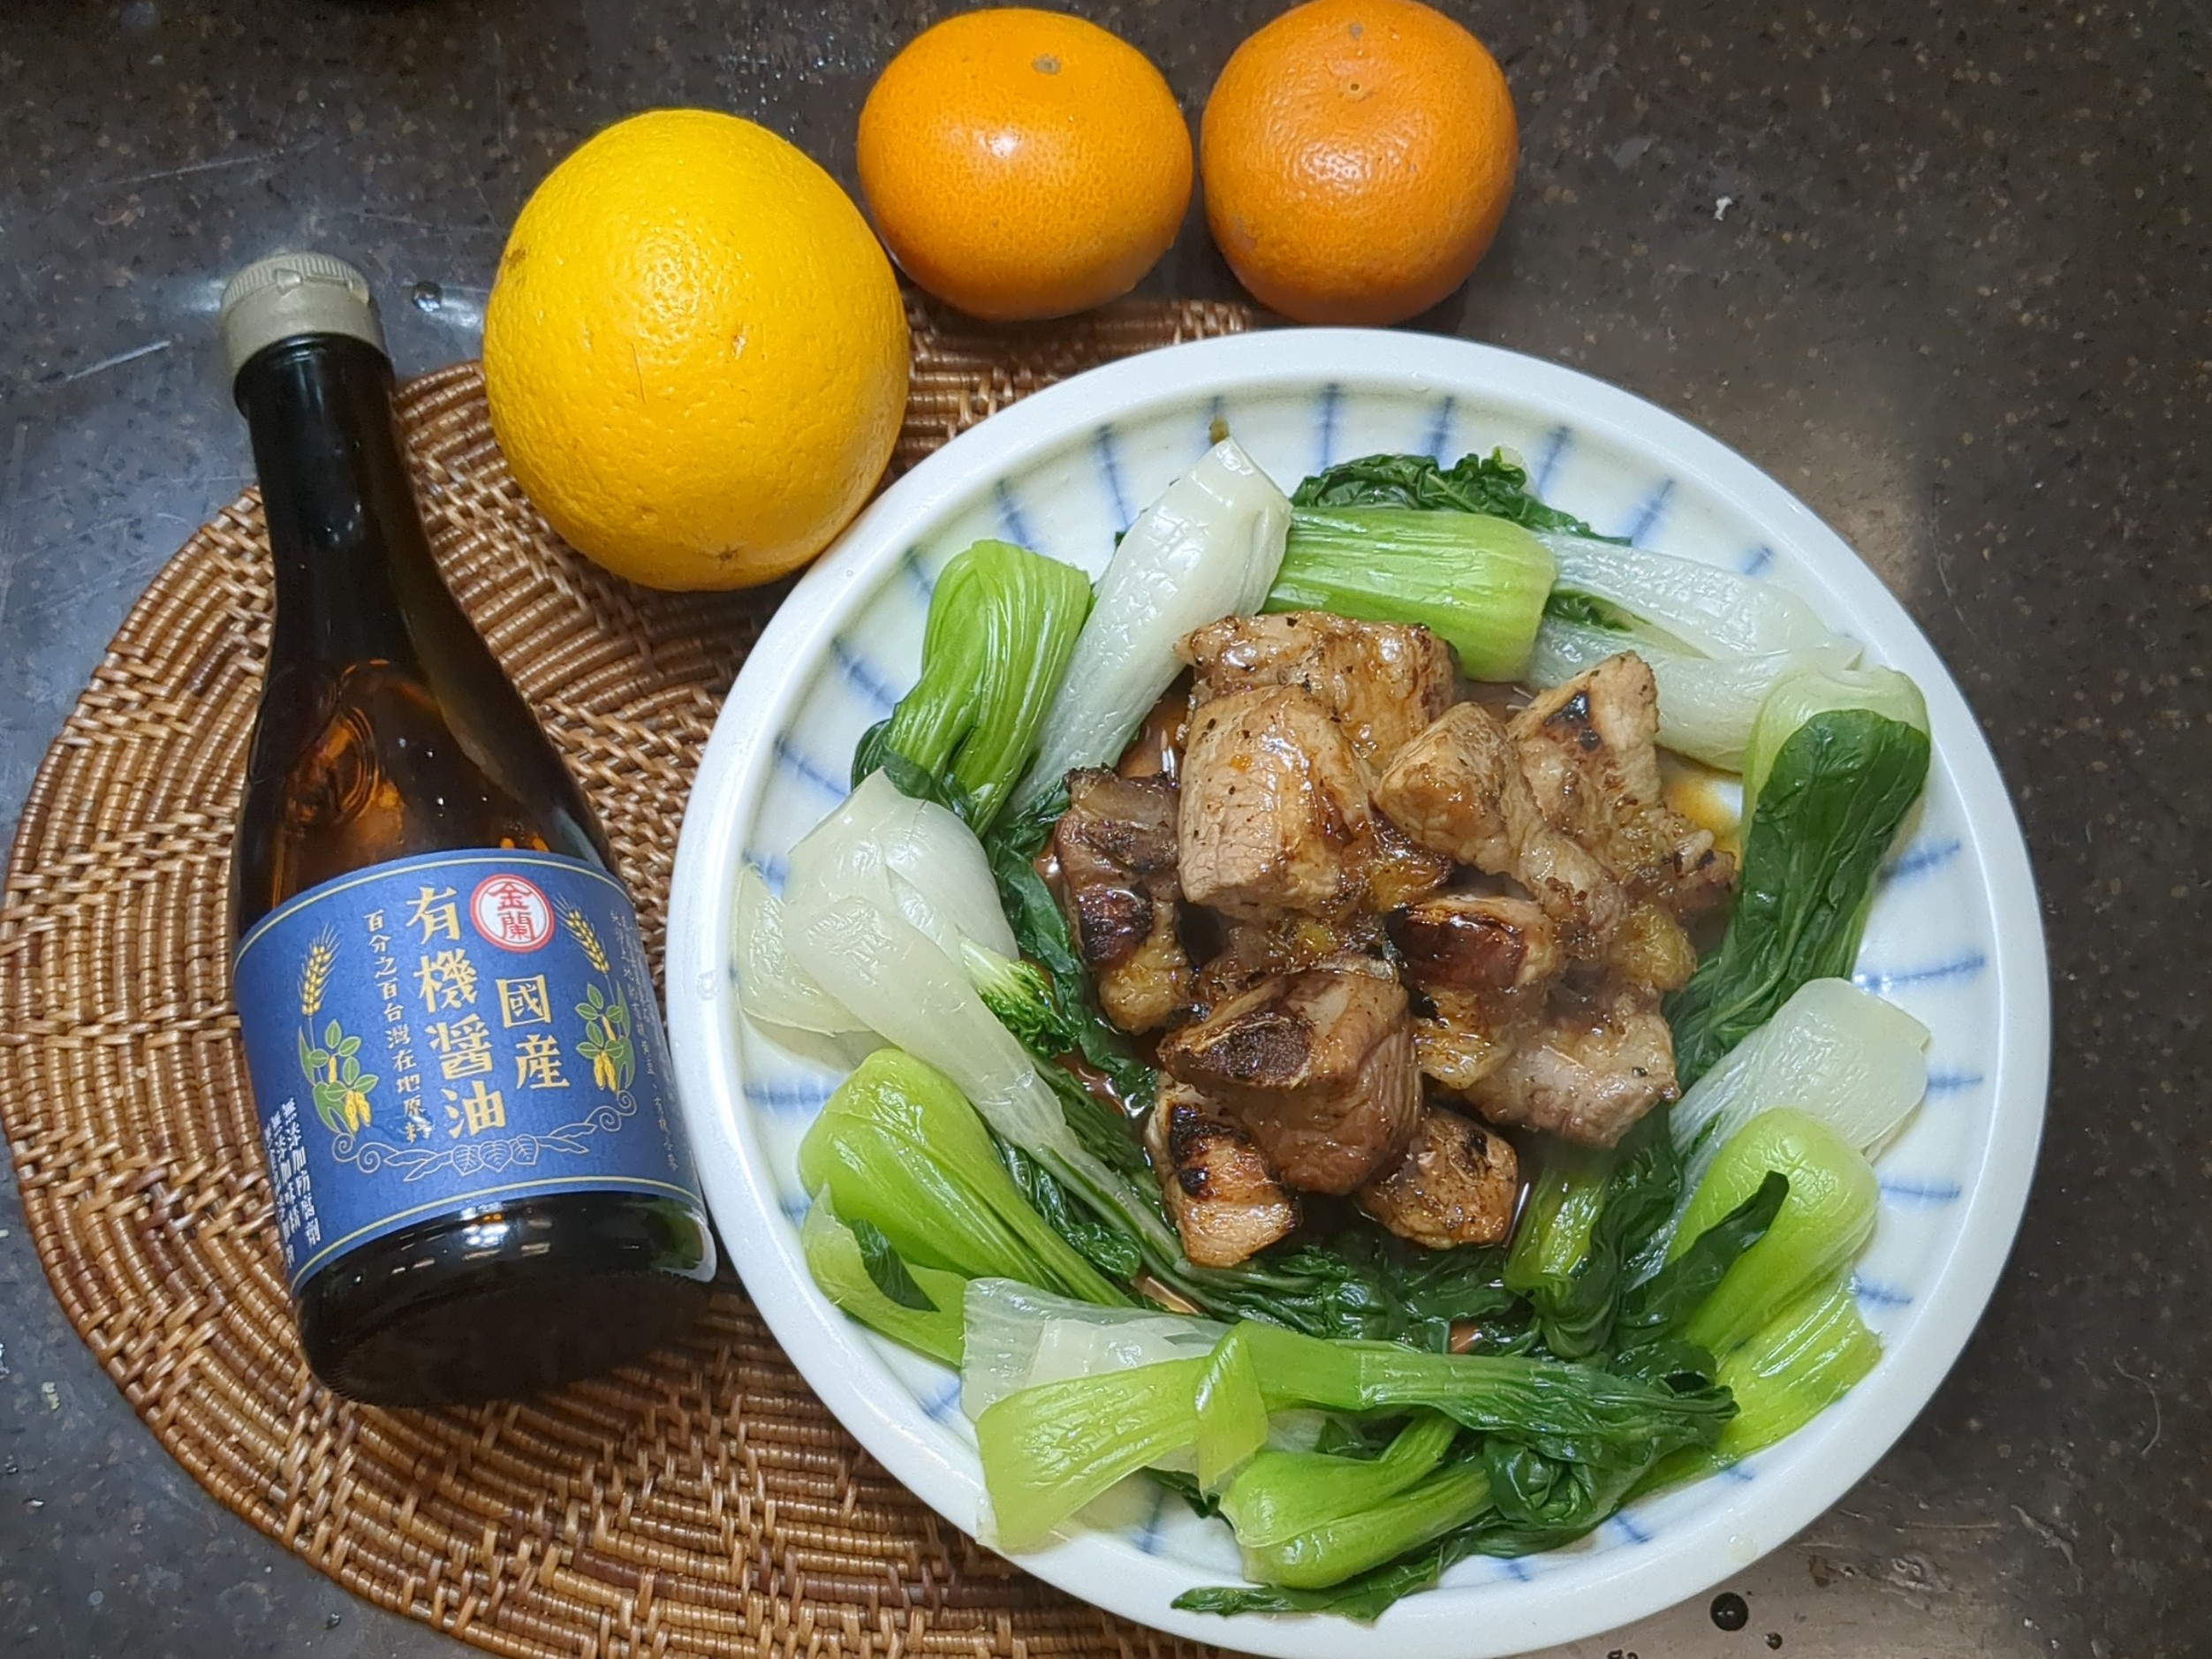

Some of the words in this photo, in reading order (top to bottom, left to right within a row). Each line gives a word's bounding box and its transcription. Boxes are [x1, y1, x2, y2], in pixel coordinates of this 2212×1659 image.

[487, 883, 536, 942] 金蘭
[363, 909, 435, 1143] 百分之百台灣在地原料
[282, 1097, 321, 1249] 無添加防腐劑
